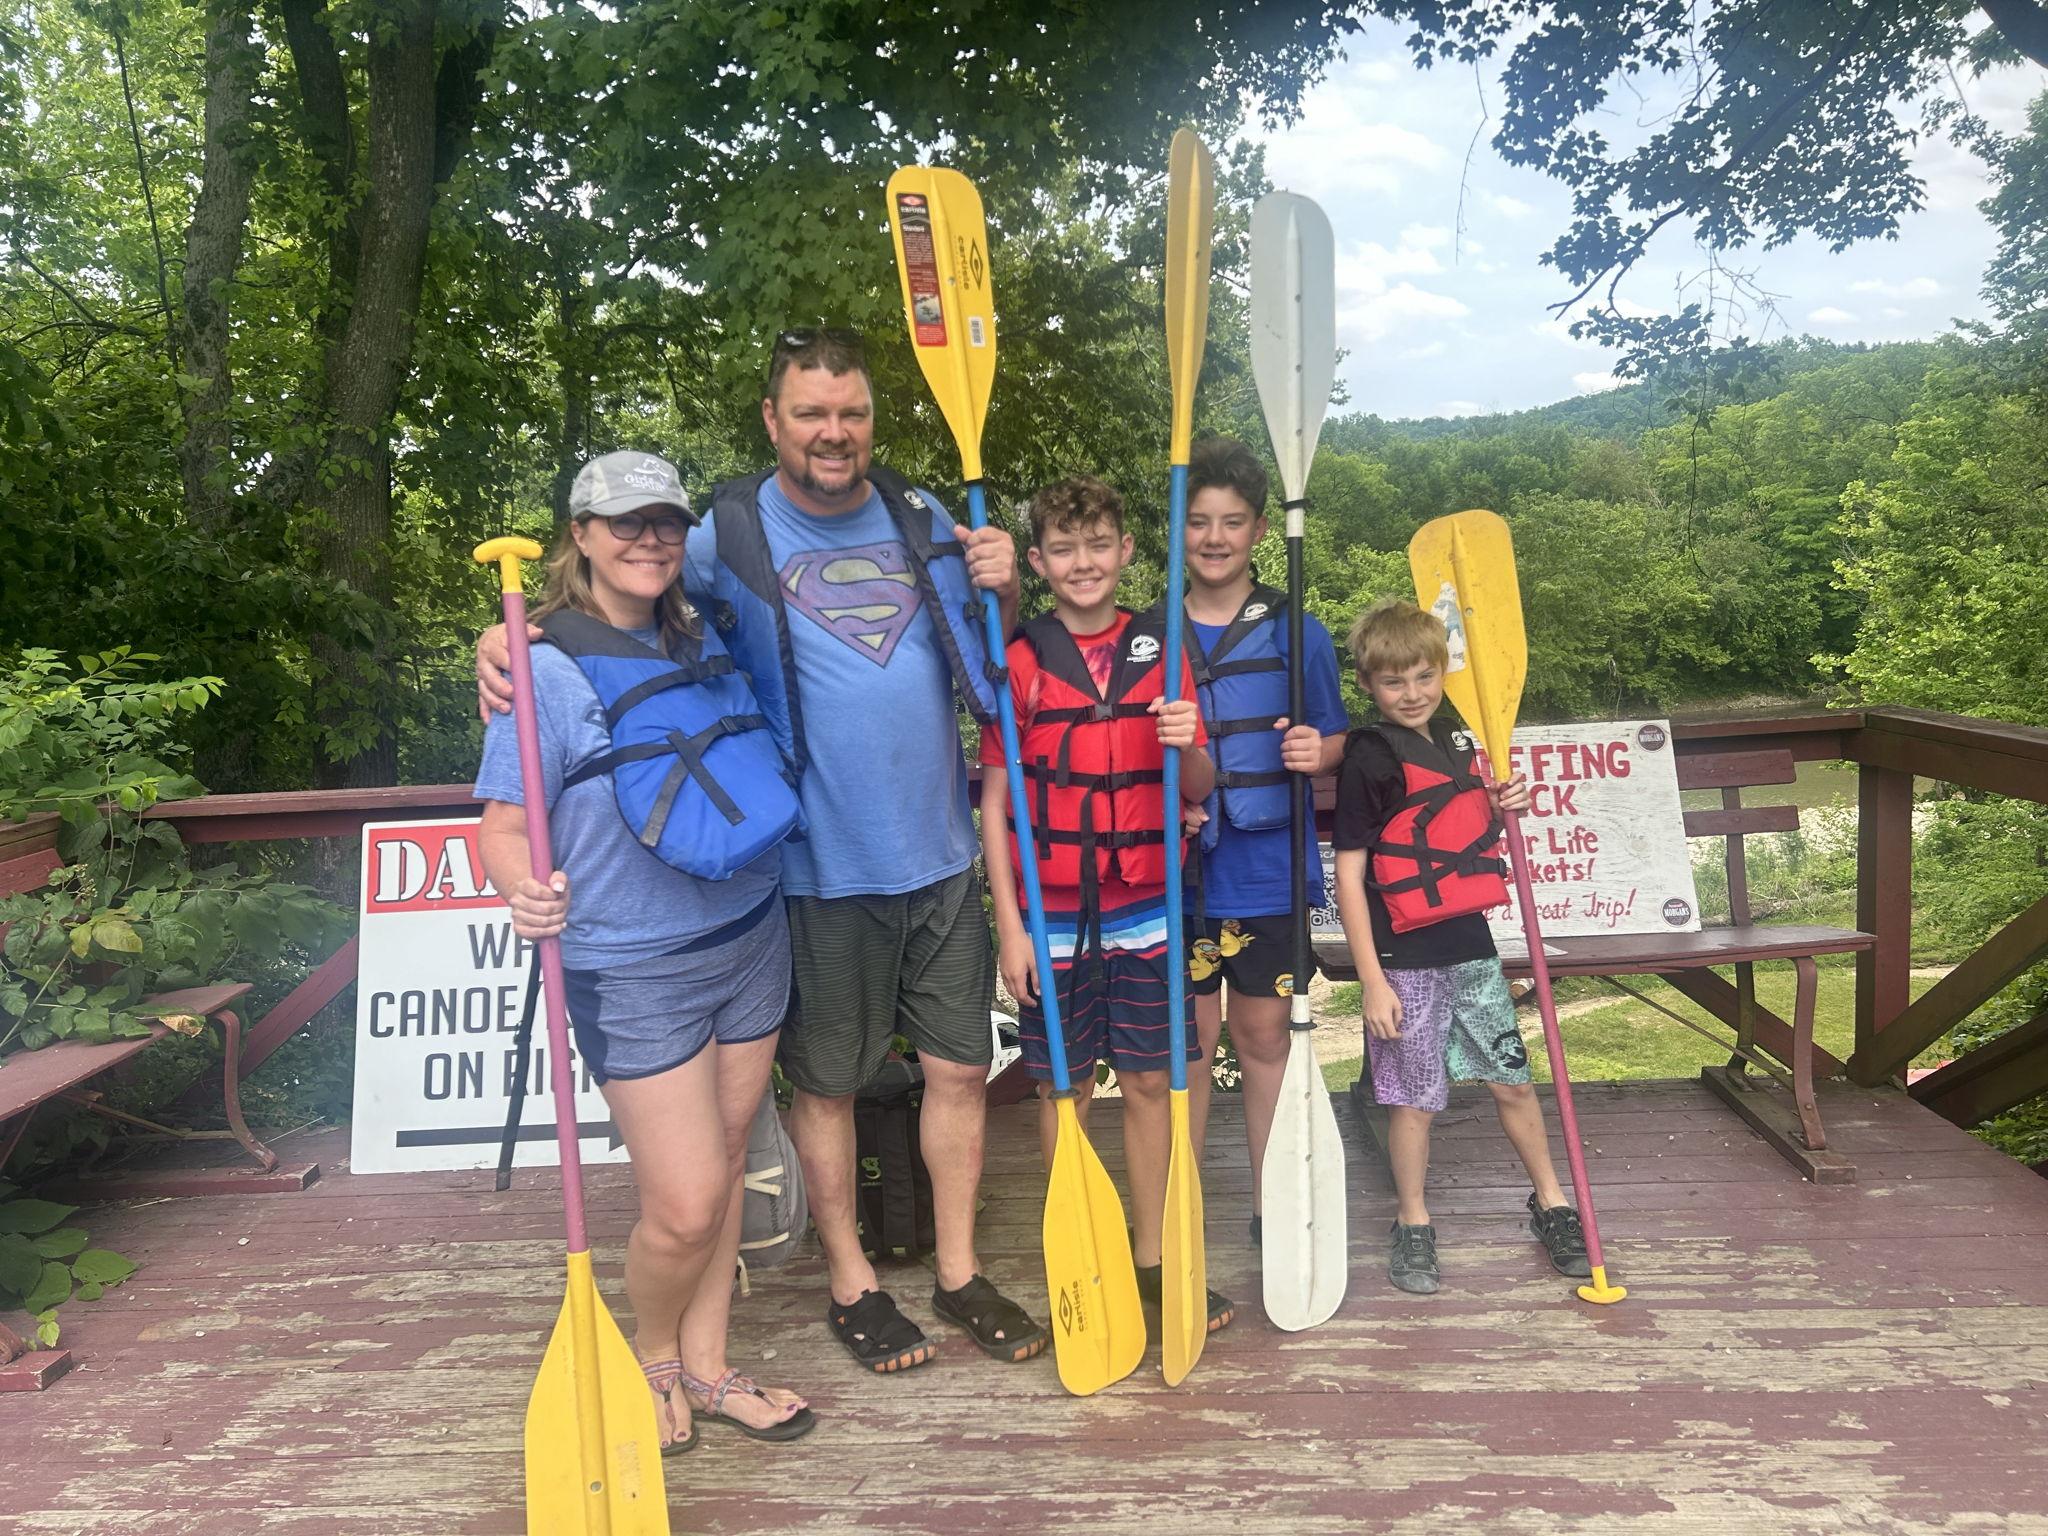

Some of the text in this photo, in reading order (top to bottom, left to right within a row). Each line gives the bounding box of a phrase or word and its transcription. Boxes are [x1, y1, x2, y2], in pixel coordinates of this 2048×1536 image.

[1519, 783, 1578, 818] CK
[1547, 825, 1599, 855] Life
[374, 836, 498, 903] DA
[1582, 888, 1637, 928] Trip!
[370, 985, 518, 1038] CANOE
[423, 1051, 484, 1100] ON
